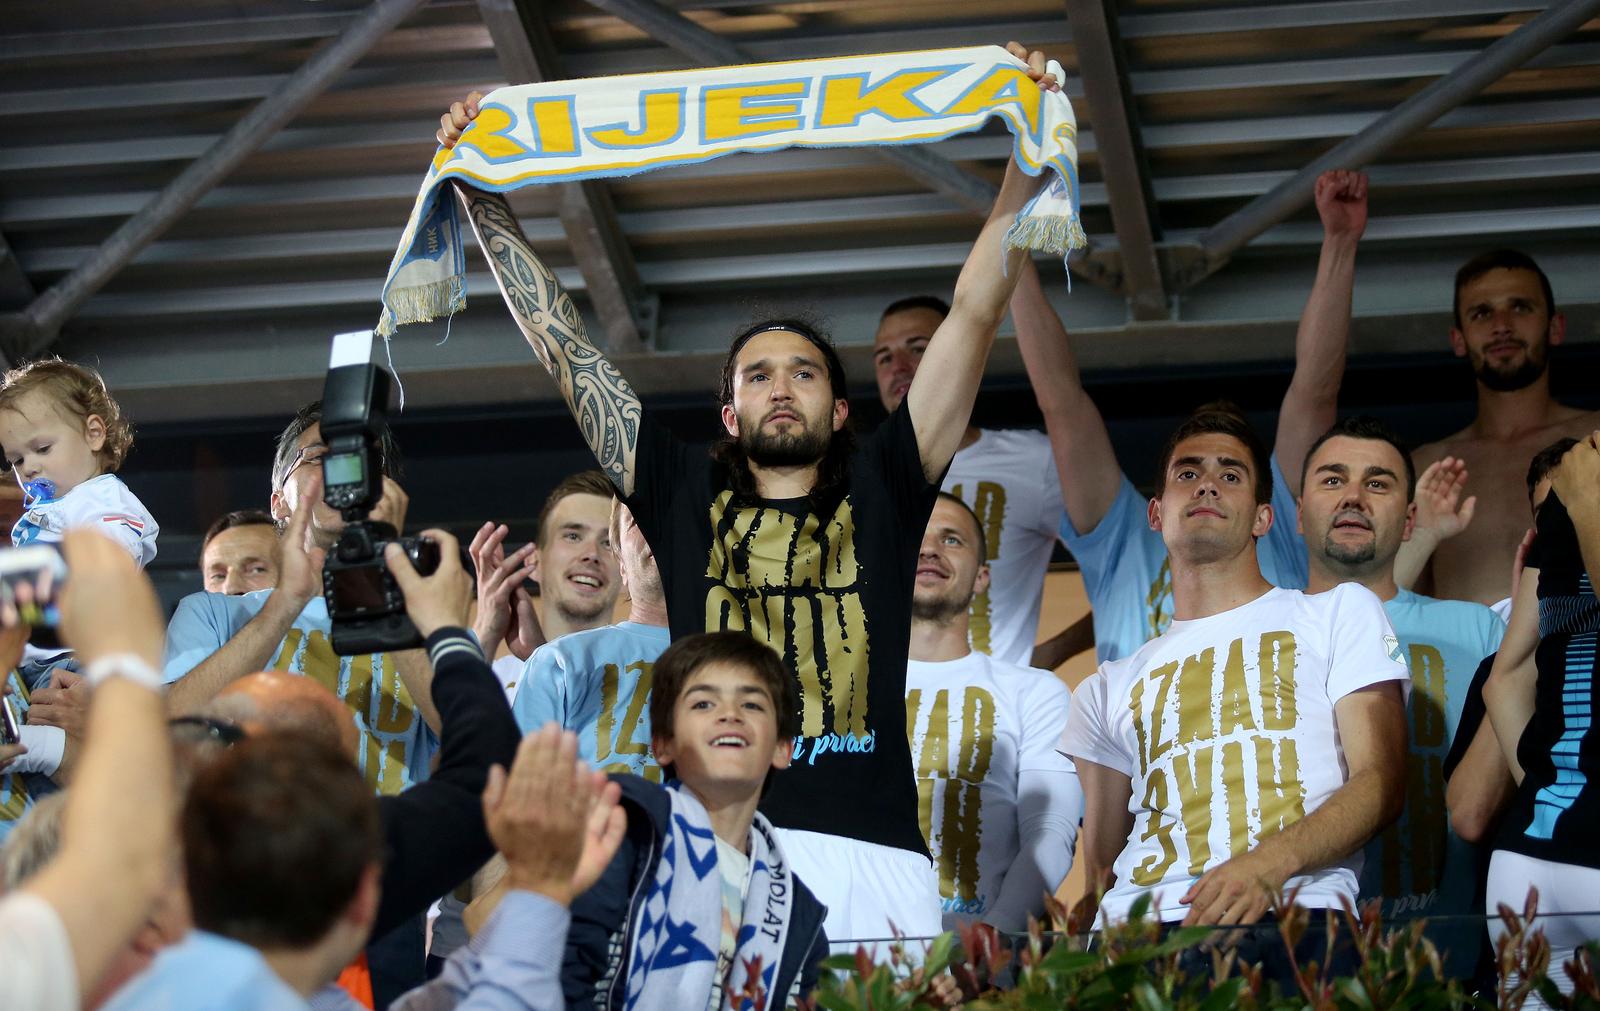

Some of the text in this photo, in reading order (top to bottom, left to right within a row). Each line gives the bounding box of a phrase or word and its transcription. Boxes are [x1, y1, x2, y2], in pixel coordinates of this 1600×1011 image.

[431, 62, 1043, 176] RIJEKA
[705, 489, 860, 588] IZNAD
[808, 728, 876, 766] prvaci
[1129, 630, 1298, 779] IZNAD
[1130, 735, 1306, 886] SVIH
[761, 861, 786, 943] MOLAT
